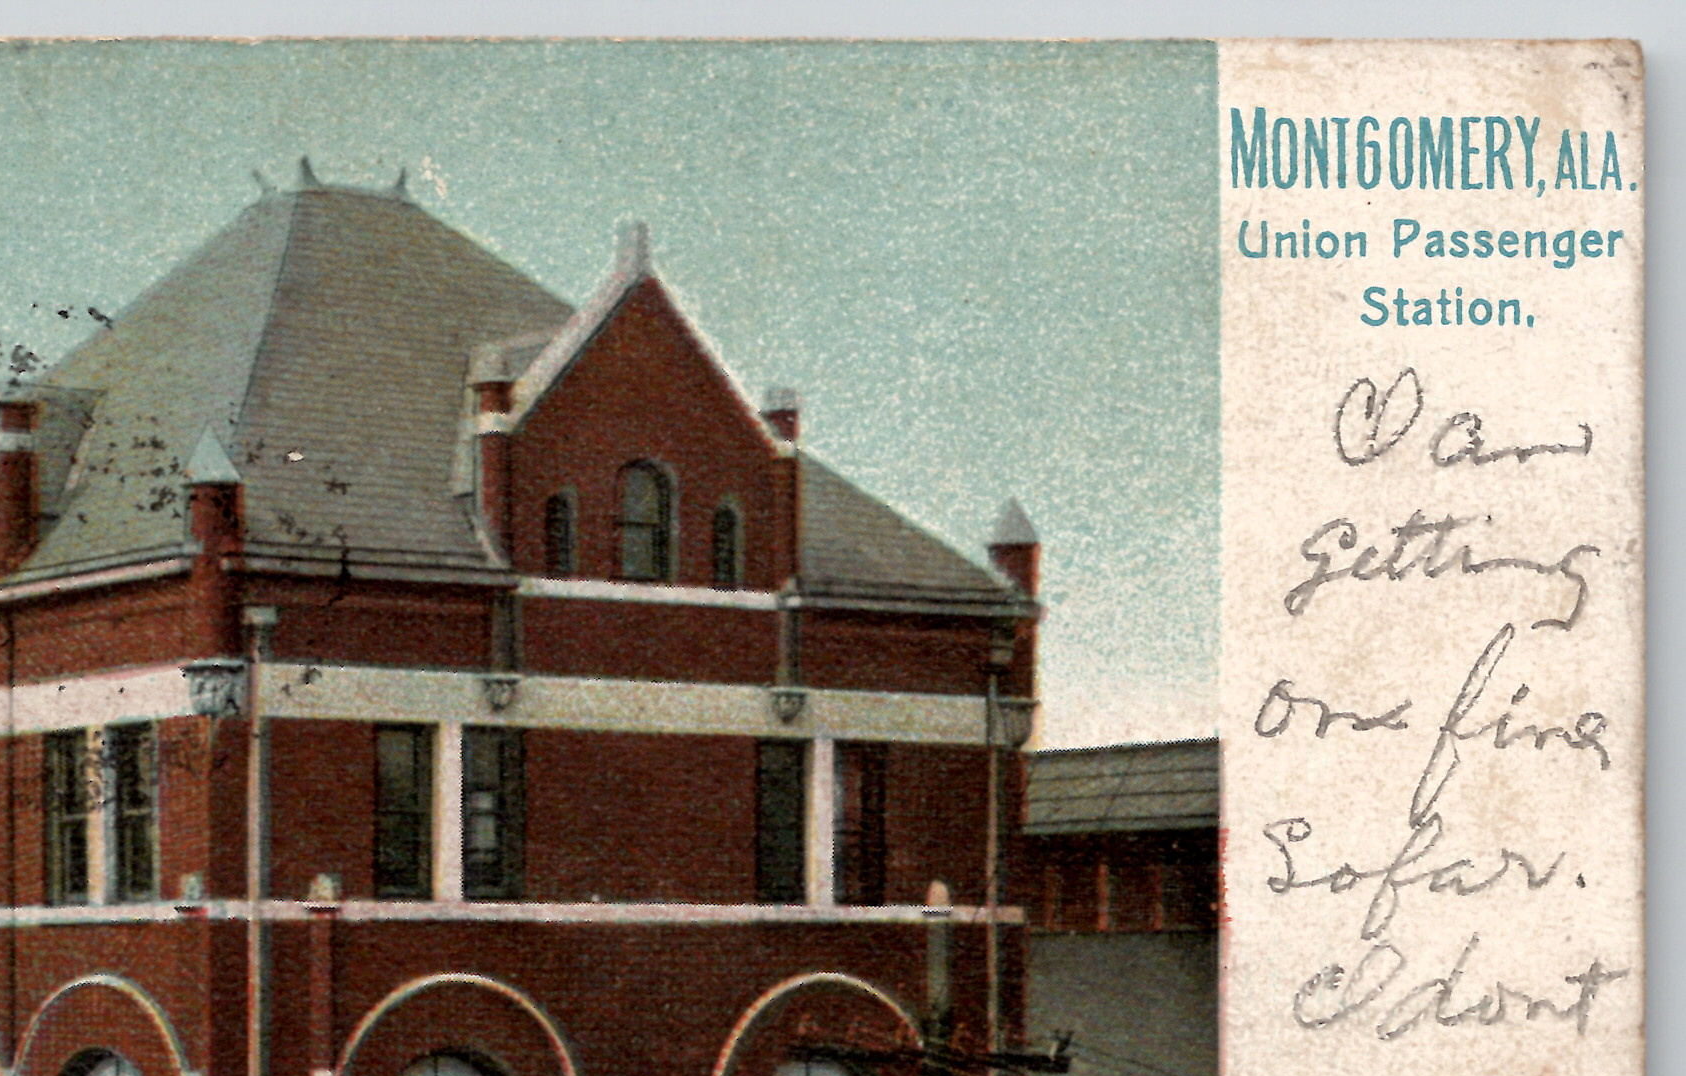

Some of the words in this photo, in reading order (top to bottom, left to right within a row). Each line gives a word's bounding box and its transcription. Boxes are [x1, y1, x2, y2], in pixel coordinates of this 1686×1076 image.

[1230, 106, 1546, 198] MONTGOMERY,
[1554, 128, 1638, 192] ALA.
[1238, 218, 1367, 259] Union
[1393, 218, 1624, 269] Passenger
[1360, 286, 1535, 328] Station.
[1408, 622, 1611, 830] fine
